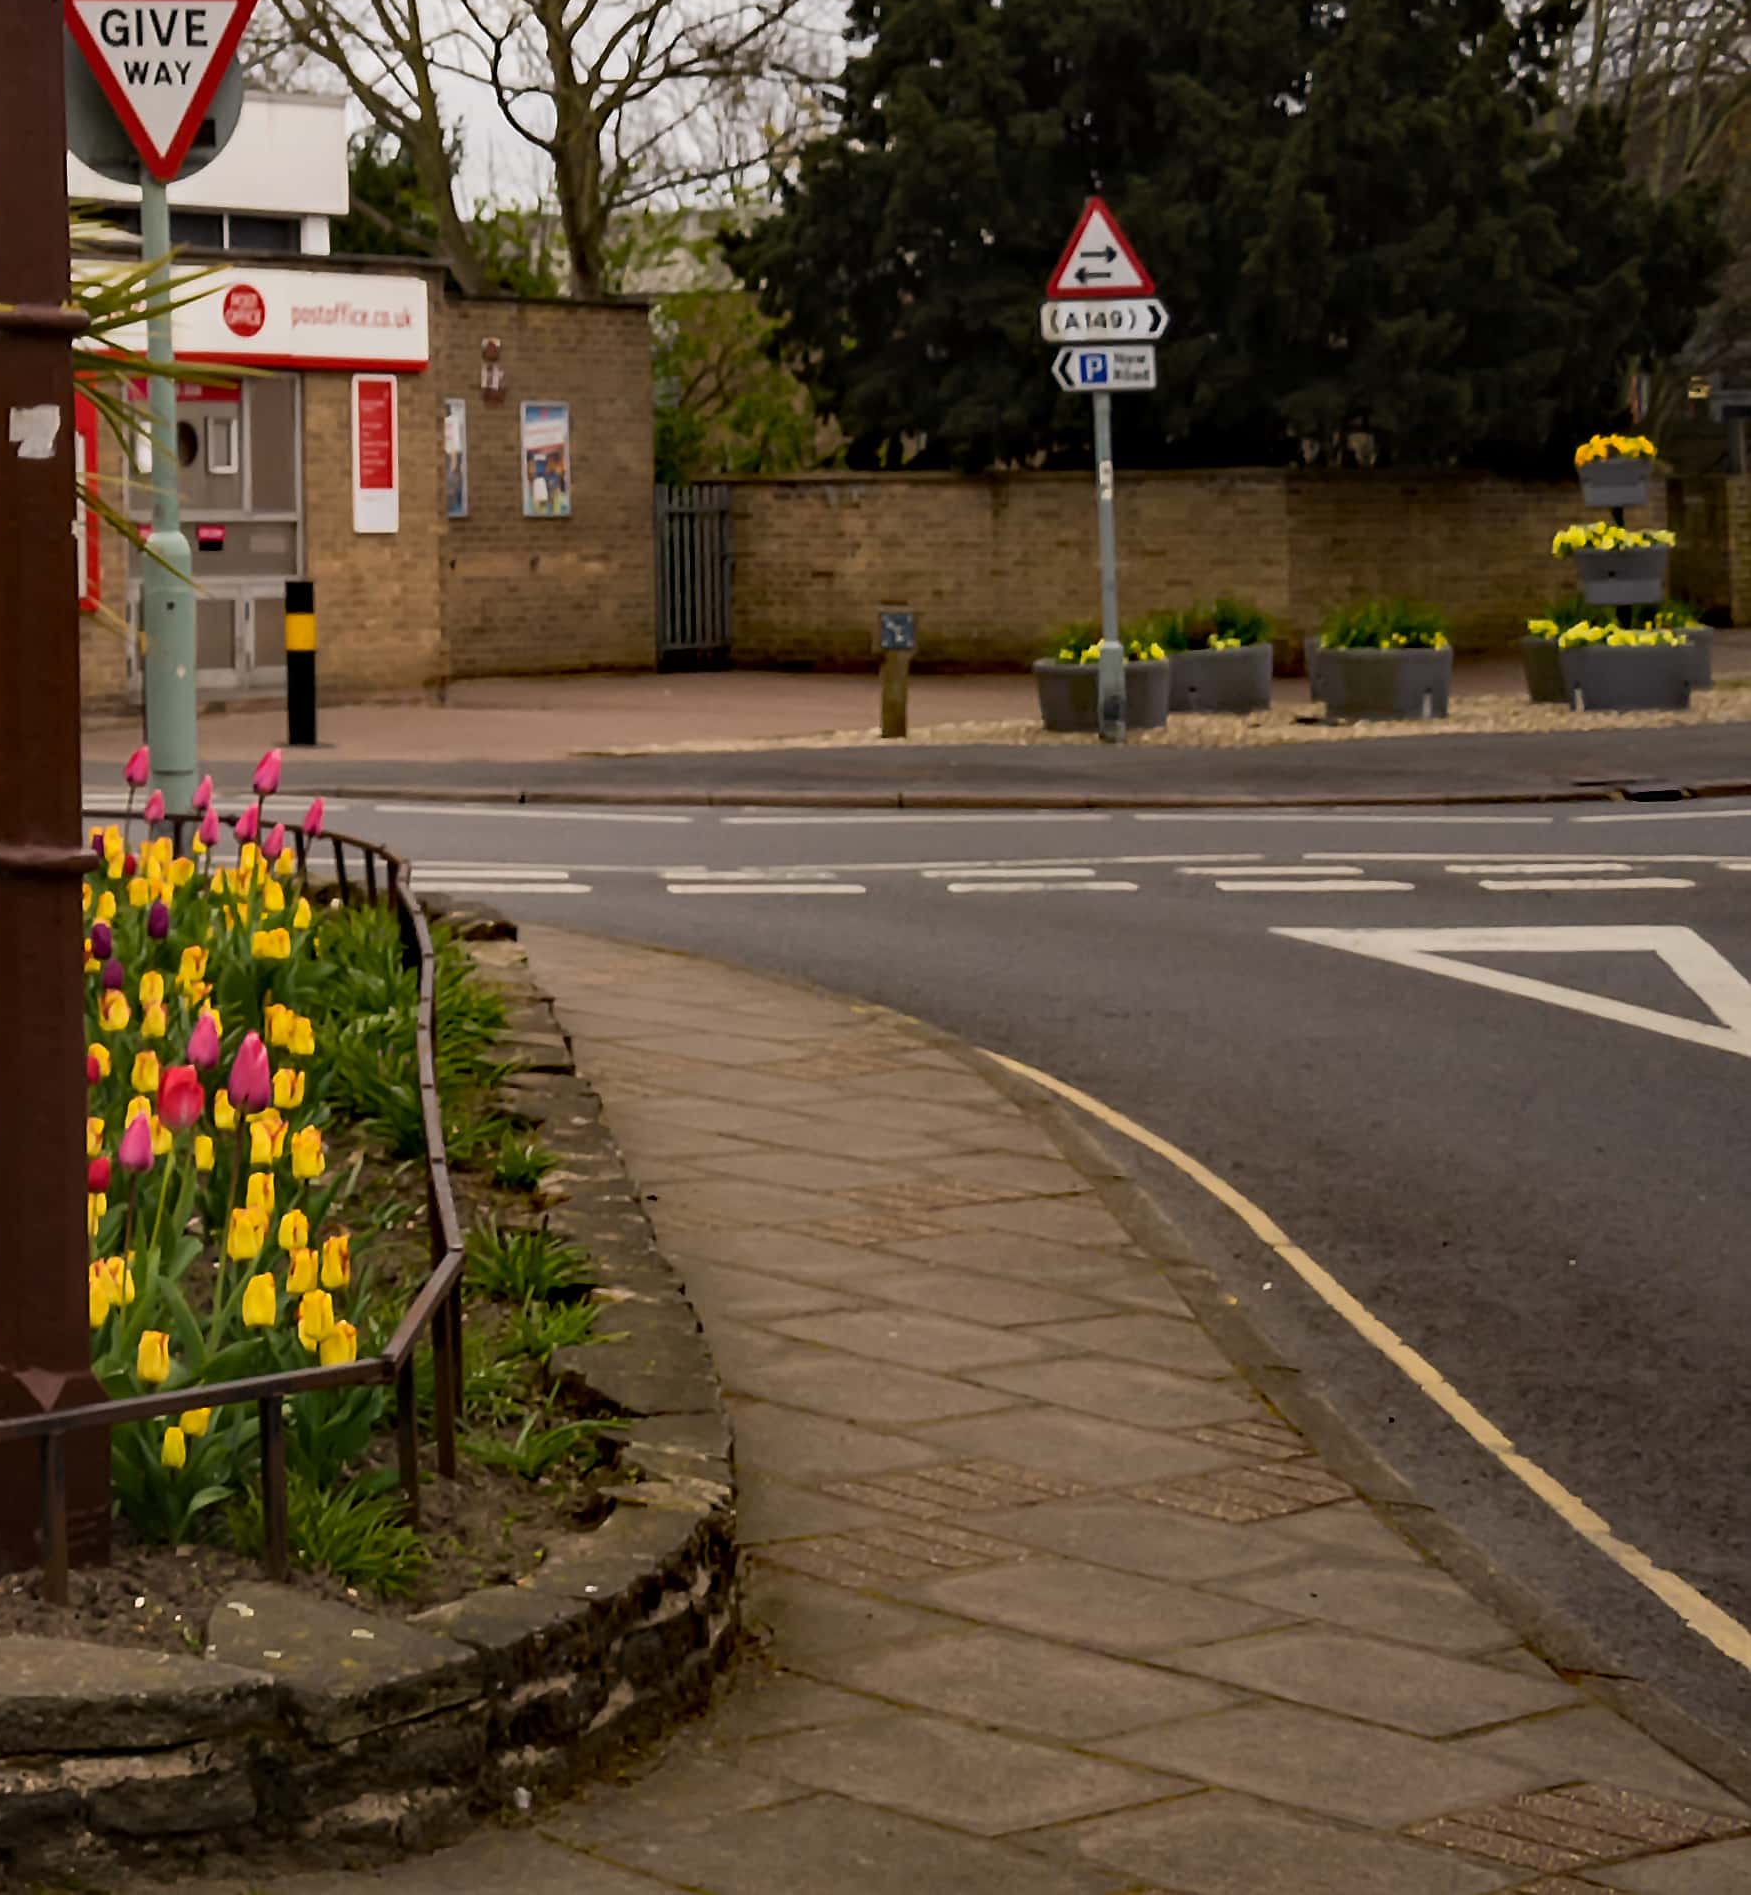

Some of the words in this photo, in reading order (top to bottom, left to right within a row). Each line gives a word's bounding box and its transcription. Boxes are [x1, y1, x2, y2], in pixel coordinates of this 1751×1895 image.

[99, 8, 209, 49] GIVE
[123, 60, 193, 86] WAY
[230, 291, 258, 309] POST
[290, 303, 412, 330] postoffice.co.uk
